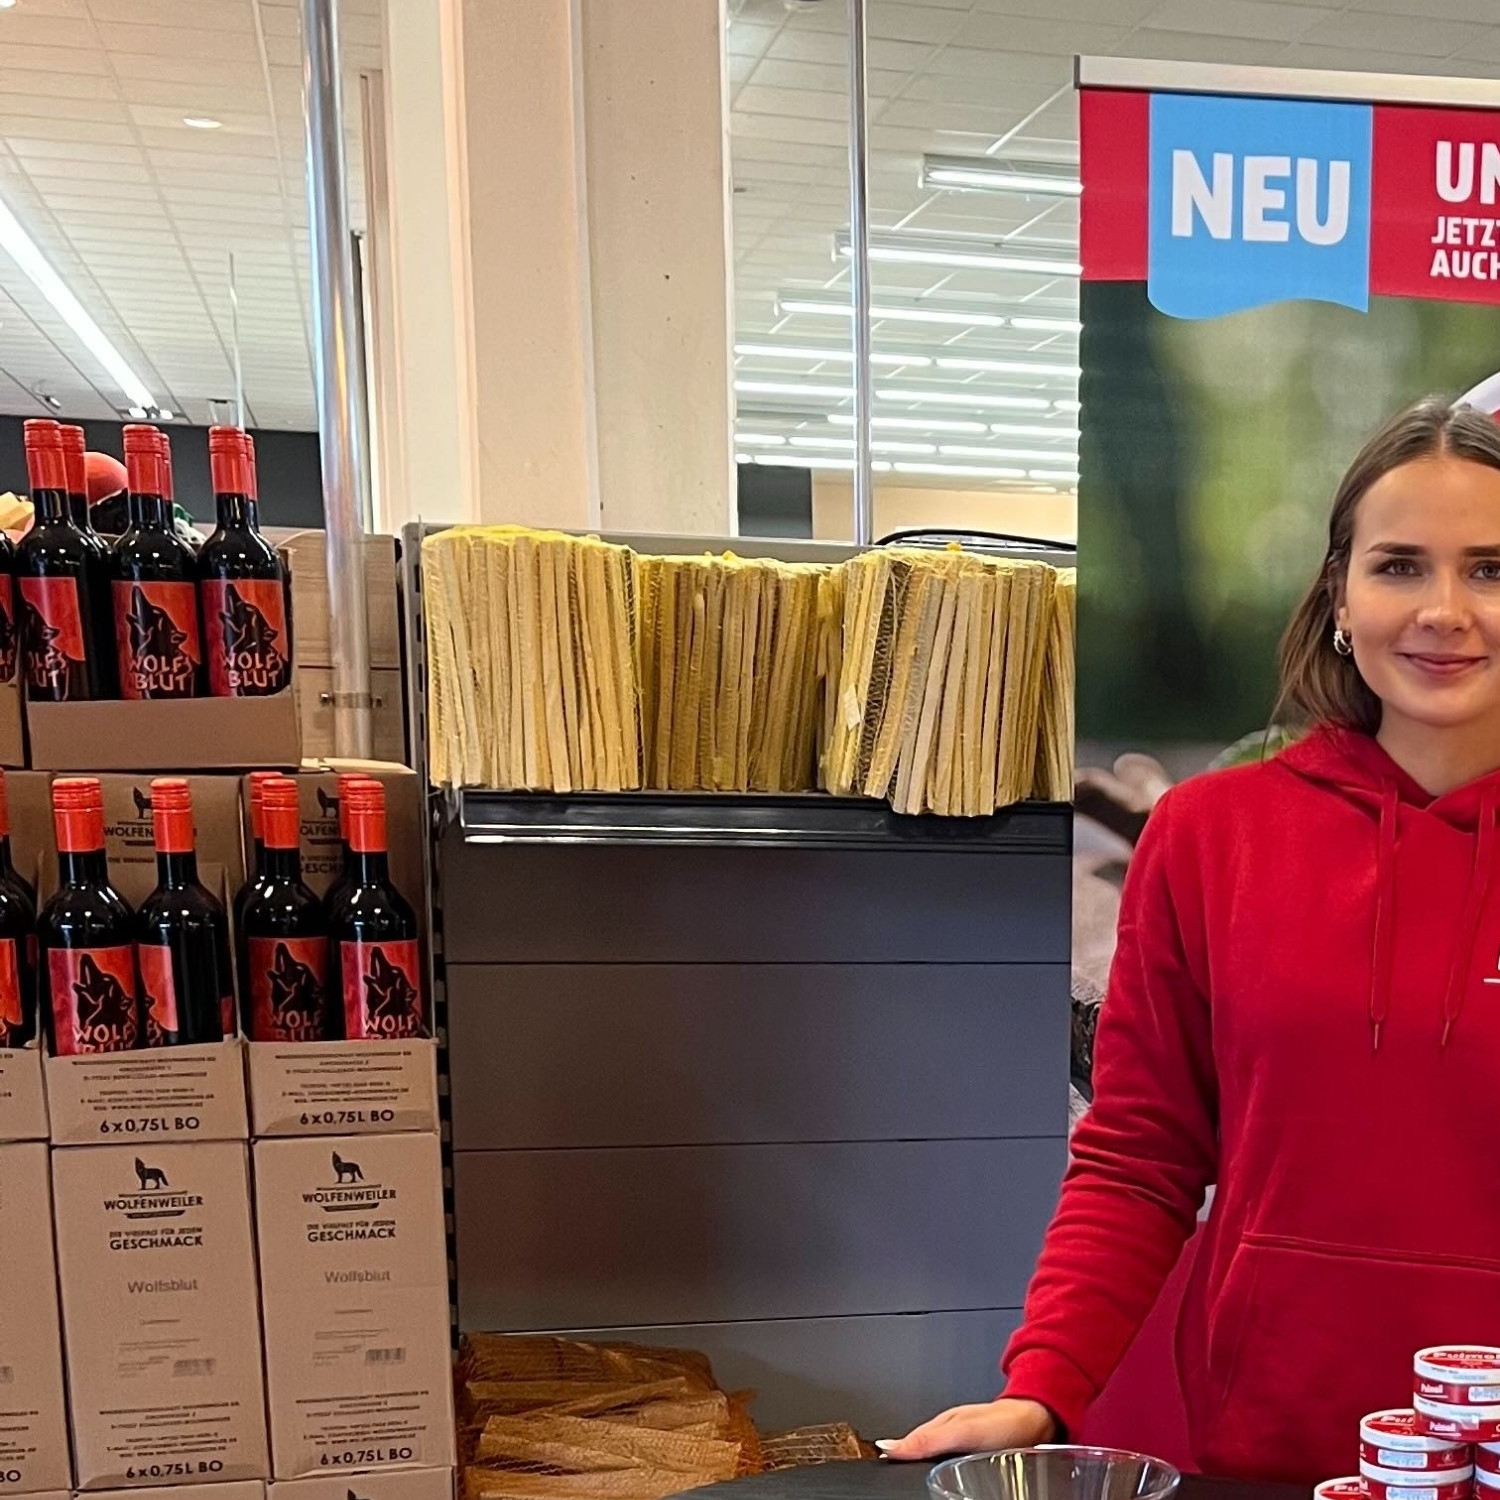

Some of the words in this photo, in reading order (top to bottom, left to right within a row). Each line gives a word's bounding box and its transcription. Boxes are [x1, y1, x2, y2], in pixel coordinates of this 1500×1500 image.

[1171, 150, 1351, 245] NEU
[134, 673, 192, 692] BLUT
[228, 669, 279, 688] BLUT
[174, 1115, 201, 1130] BO
[368, 1109, 395, 1123] BO
[104, 1195, 204, 1211] WOLFENWEILER
[302, 1189, 397, 1204] WOLFENWEILER
[307, 1227, 396, 1242] GESCHMACK
[110, 1235, 204, 1251] GESCHMACK
[198, 1460, 224, 1474] BO
